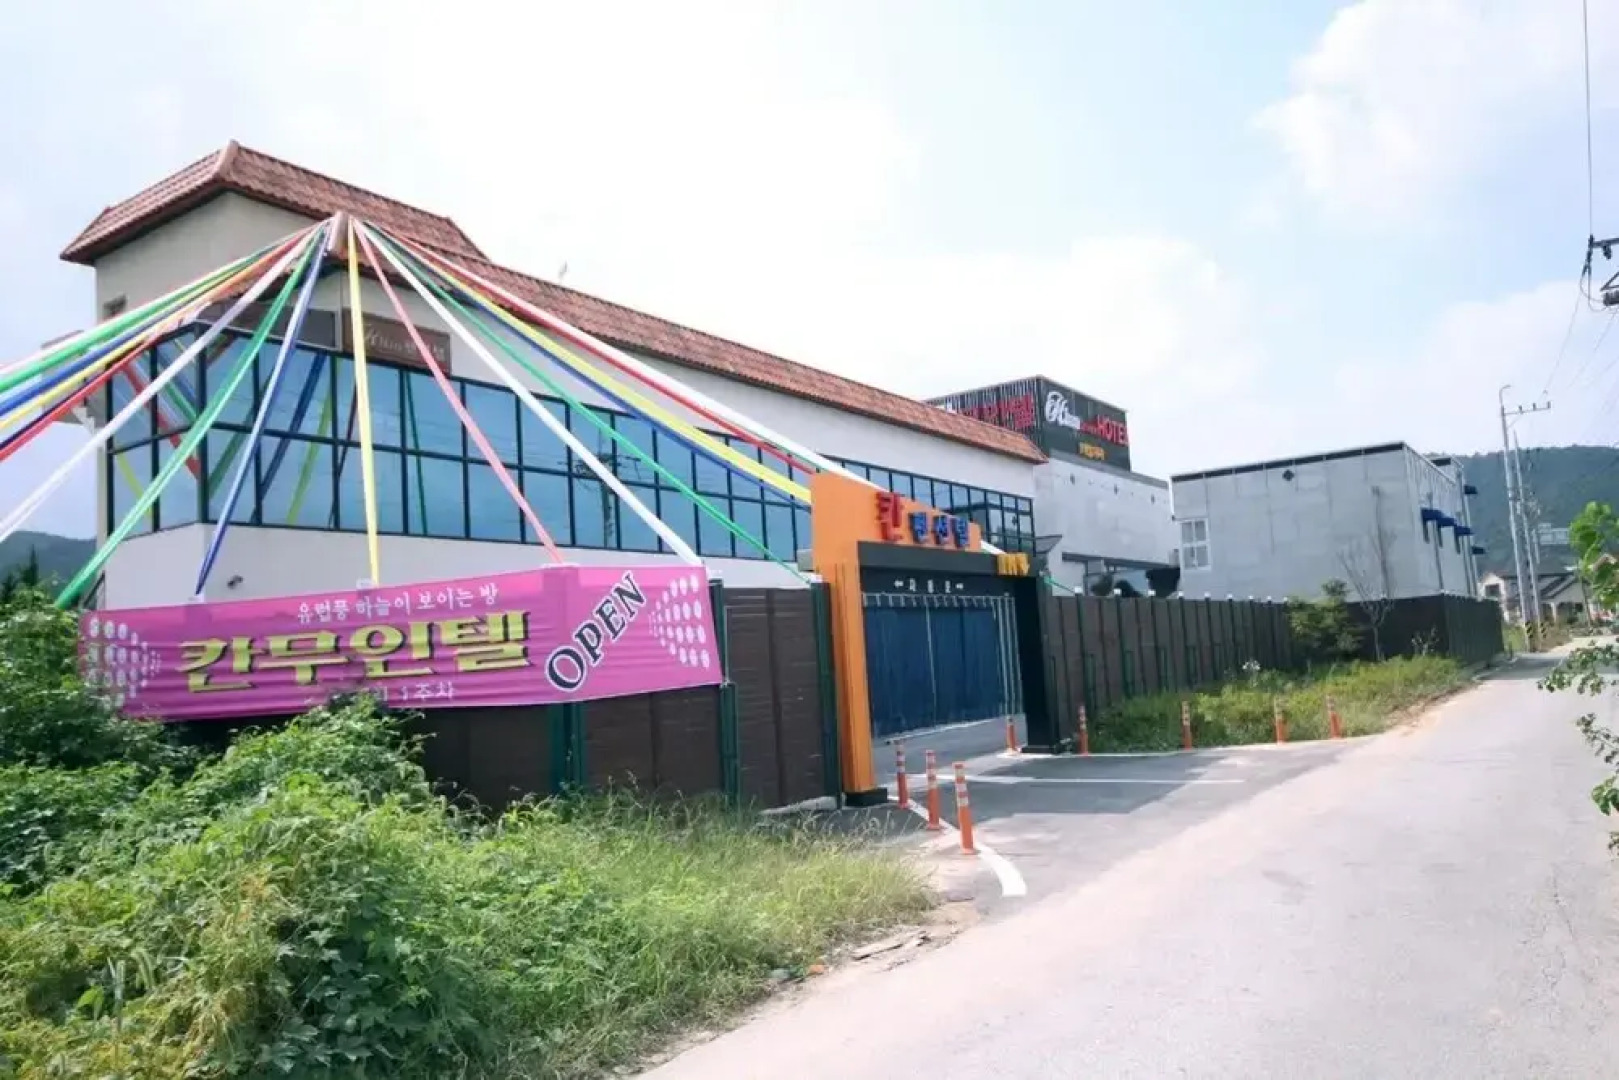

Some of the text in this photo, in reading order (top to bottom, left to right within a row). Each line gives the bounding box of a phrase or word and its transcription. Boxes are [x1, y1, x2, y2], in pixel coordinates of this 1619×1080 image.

[297, 582, 499, 625] 유럽풍 하늘이 보이는 방
[546, 571, 647, 691] OPEN
[176, 610, 532, 693] 칸무인텔
